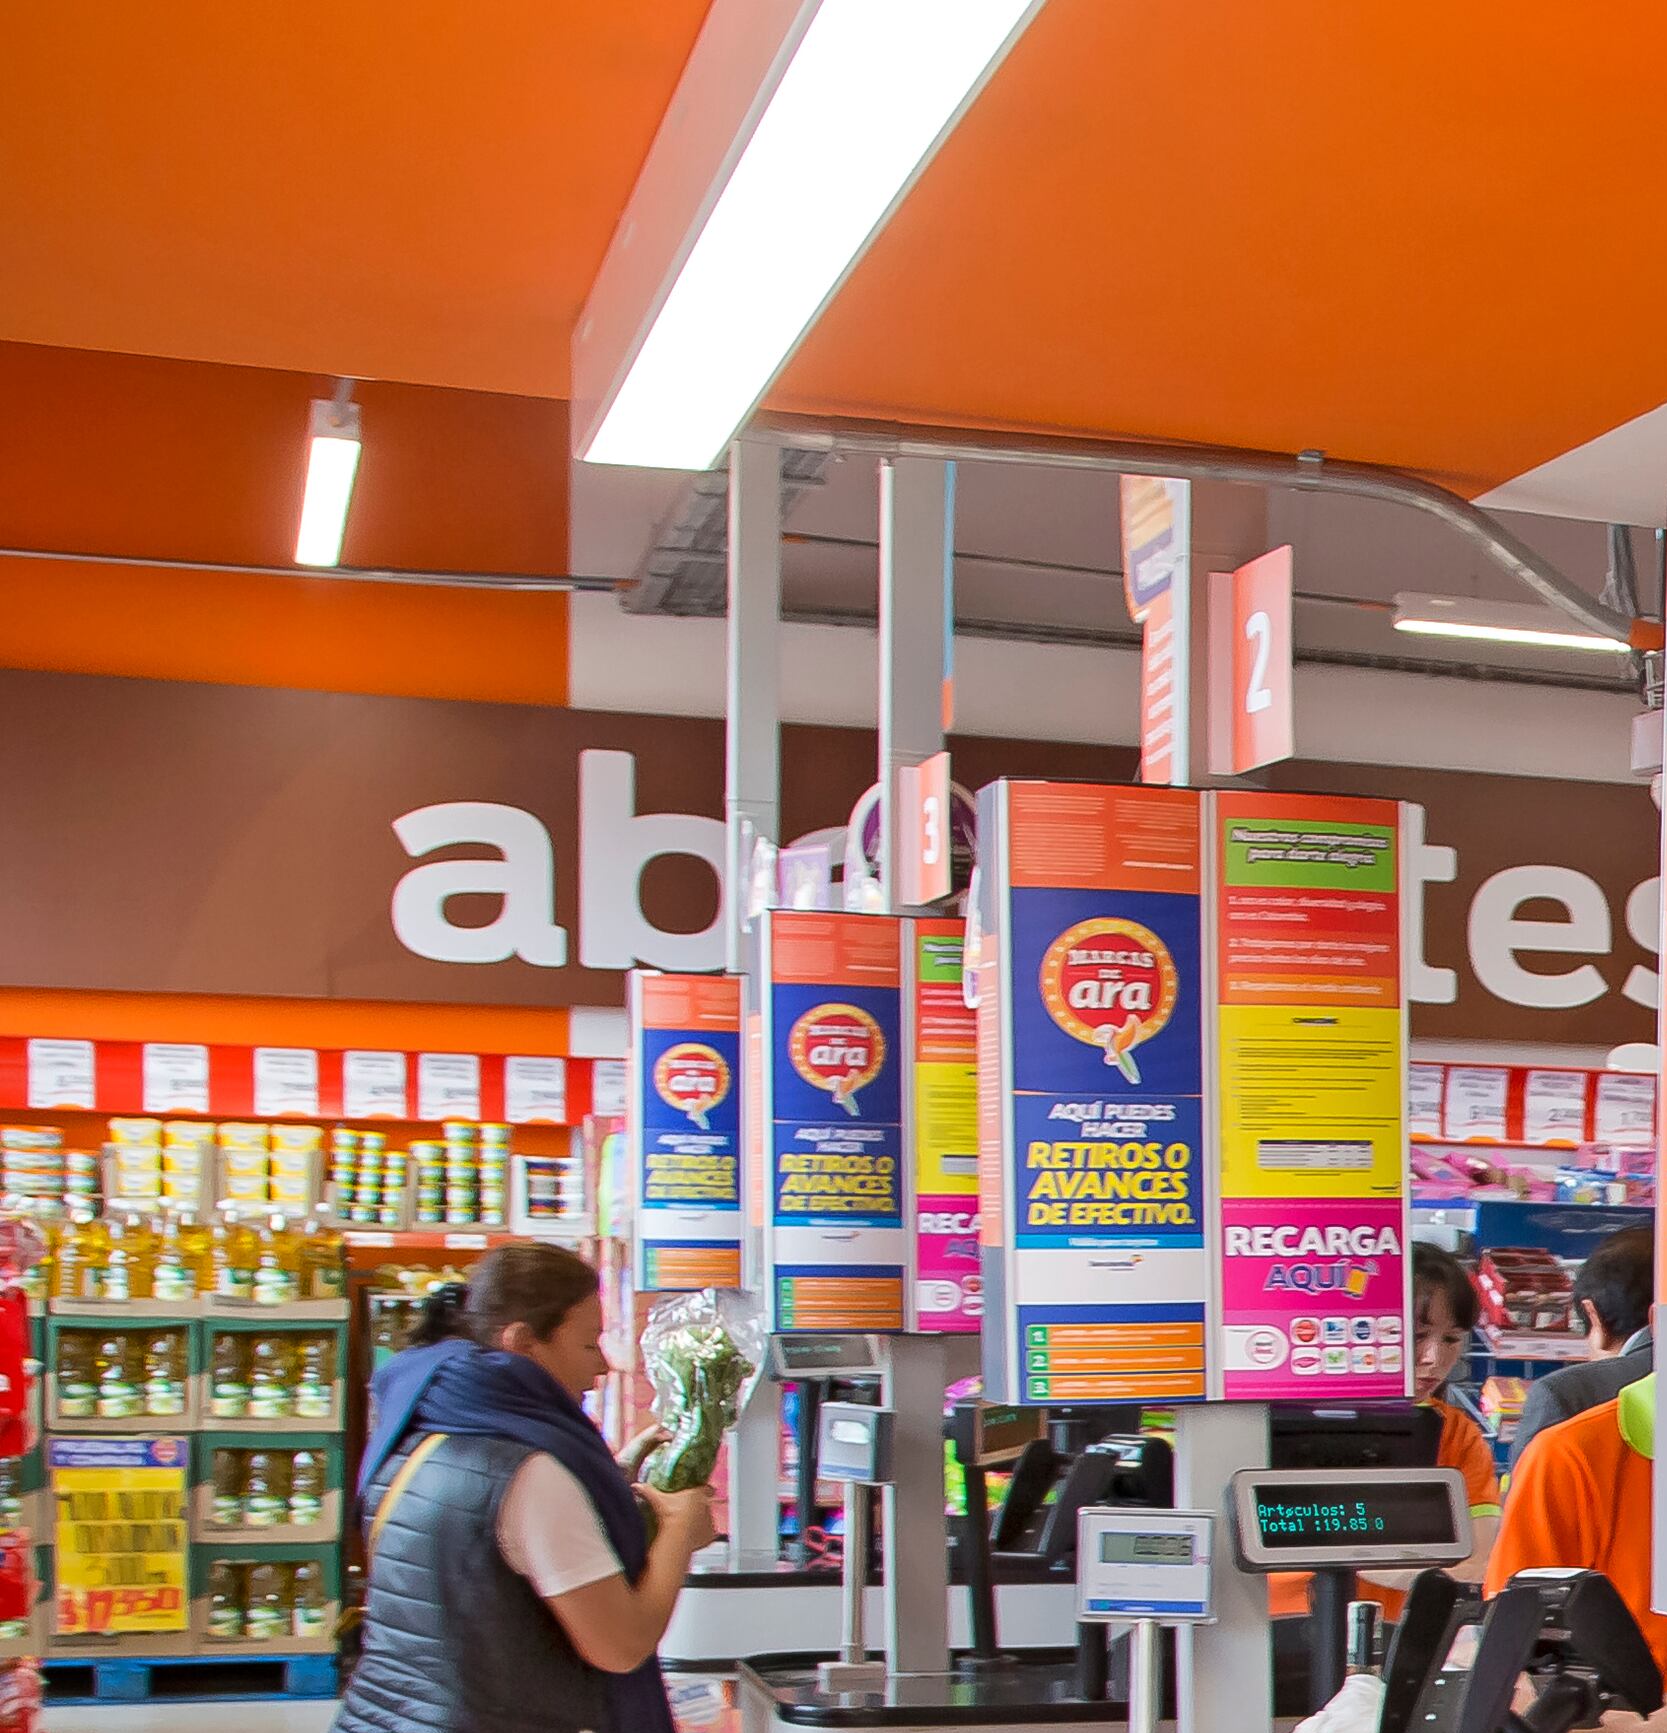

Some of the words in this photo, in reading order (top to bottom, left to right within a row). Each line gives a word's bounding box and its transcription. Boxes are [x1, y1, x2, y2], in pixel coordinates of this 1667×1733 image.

[1245, 611, 1273, 714] 2
[922, 797, 940, 865] 3
[1068, 979, 1153, 1011] ara
[1026, 1141, 1164, 1170] RETIROS
[1164, 1143, 1190, 1169] O
[1026, 1171, 1190, 1200] AVANCES
[1027, 1202, 1066, 1226] DE
[1225, 1225, 1402, 1258] RECARGA
[1265, 1259, 1348, 1294] AQUÍ
[1355, 1502, 1366, 1516] 5
[1260, 1519, 1305, 1532] Total
